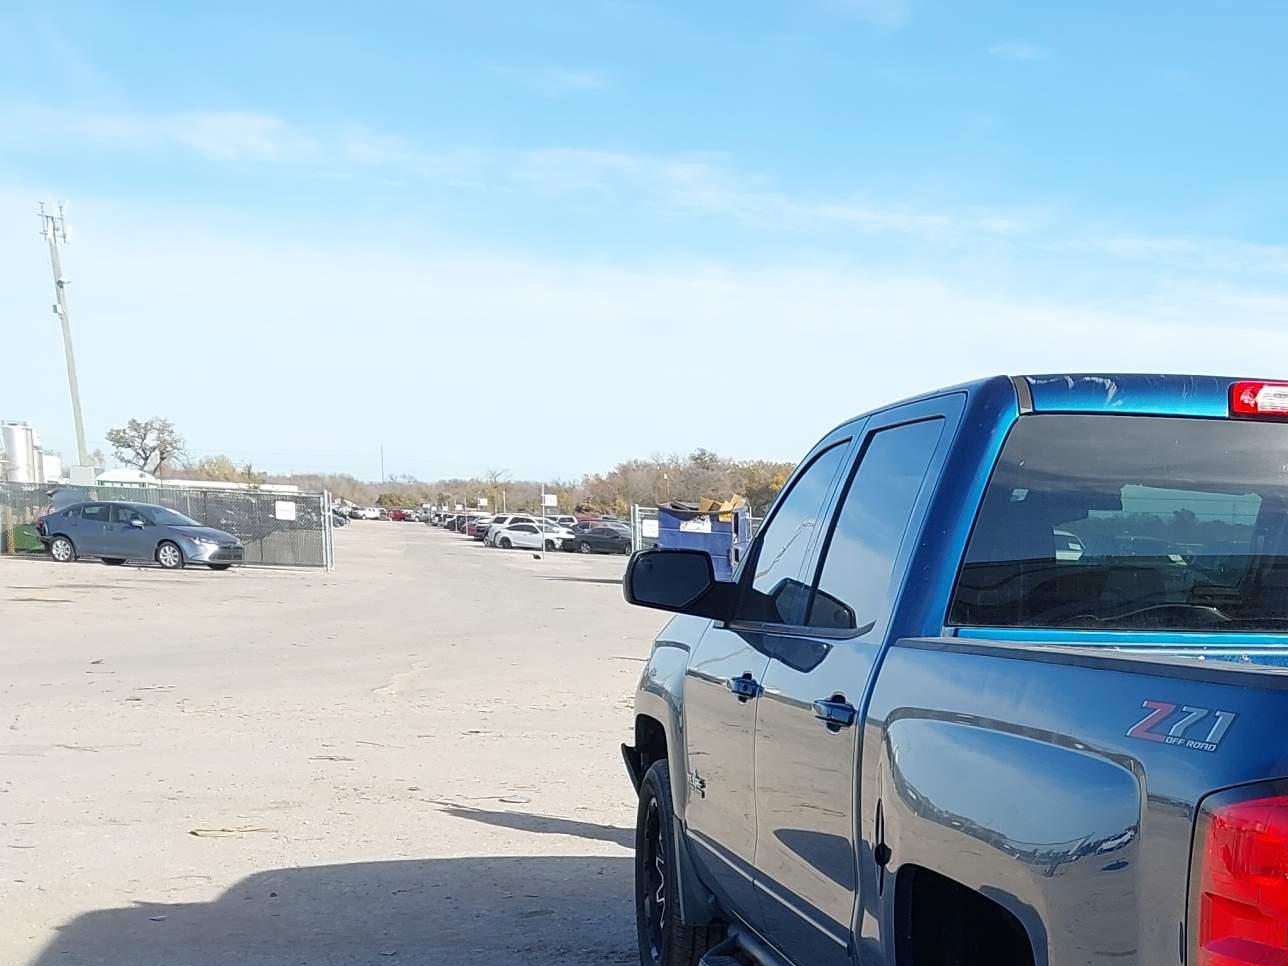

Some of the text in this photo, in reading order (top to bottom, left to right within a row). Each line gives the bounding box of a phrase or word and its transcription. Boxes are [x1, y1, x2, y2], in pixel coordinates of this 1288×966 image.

[1126, 699, 1237, 744] Z71
[1165, 736, 1217, 751] OFF ROAD
